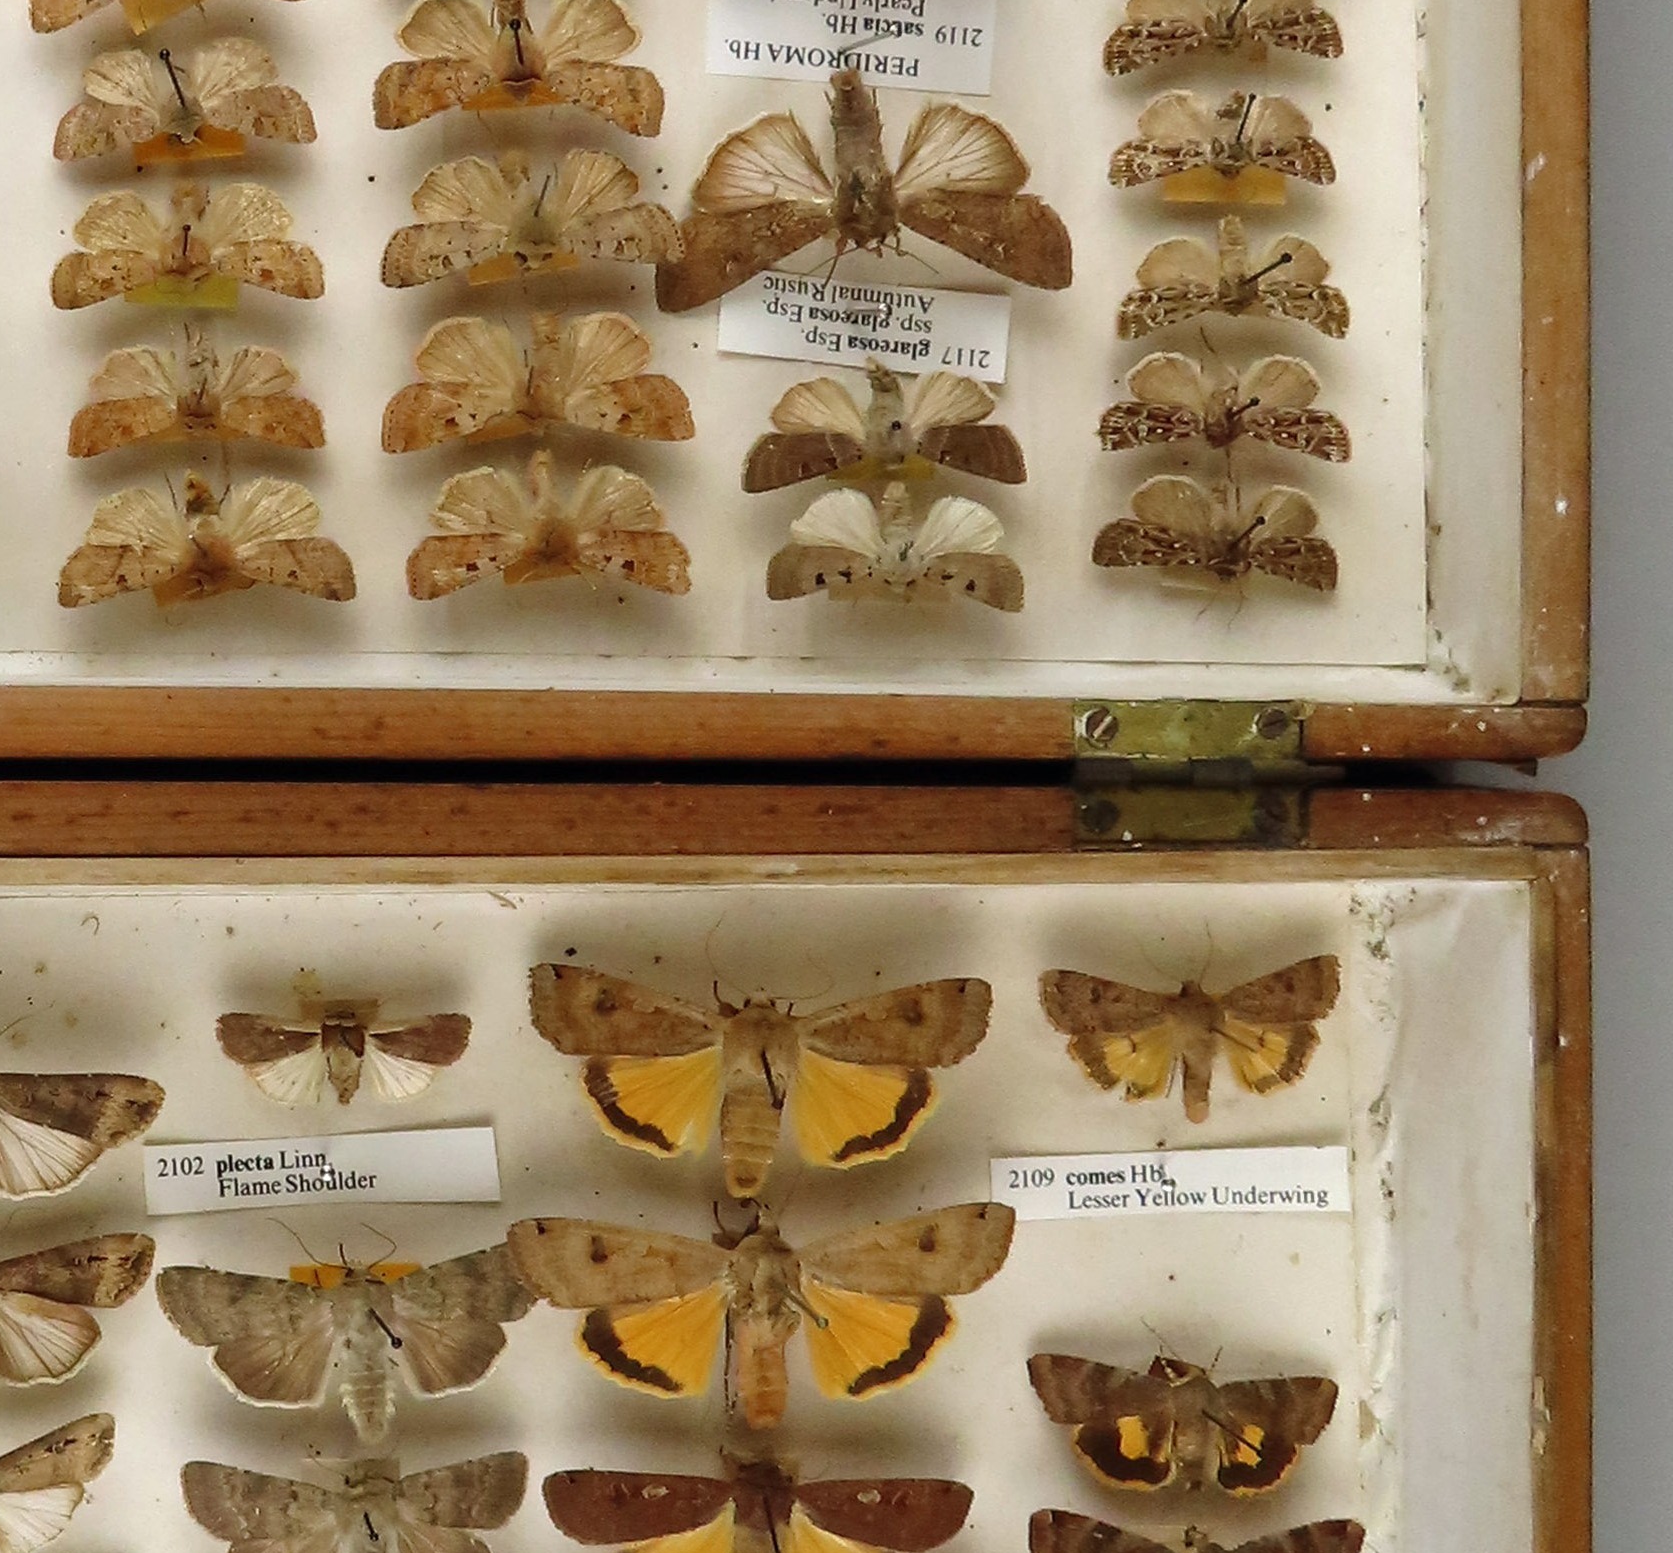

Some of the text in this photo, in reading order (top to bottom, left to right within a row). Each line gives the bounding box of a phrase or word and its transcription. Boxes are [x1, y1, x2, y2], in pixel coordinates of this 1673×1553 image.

[823, 13, 983, 46] 2119 Hb.
[725, 39, 919, 76] PERIDROMA Hb.
[763, 276, 934, 314] Autumnal Rustic
[762, 299, 932, 334] ssp. glareosa Esp.
[801, 327, 990, 368] 2117 glareosa Esp.
[157, 1157, 205, 1176] 2102
[216, 1156, 273, 1177] plecta
[1009, 1169, 1125, 1188] 2109 comes
[219, 1171, 376, 1197] Flame Shoulder
[1069, 1187, 1328, 1210] Lesser Yellow Underwing
